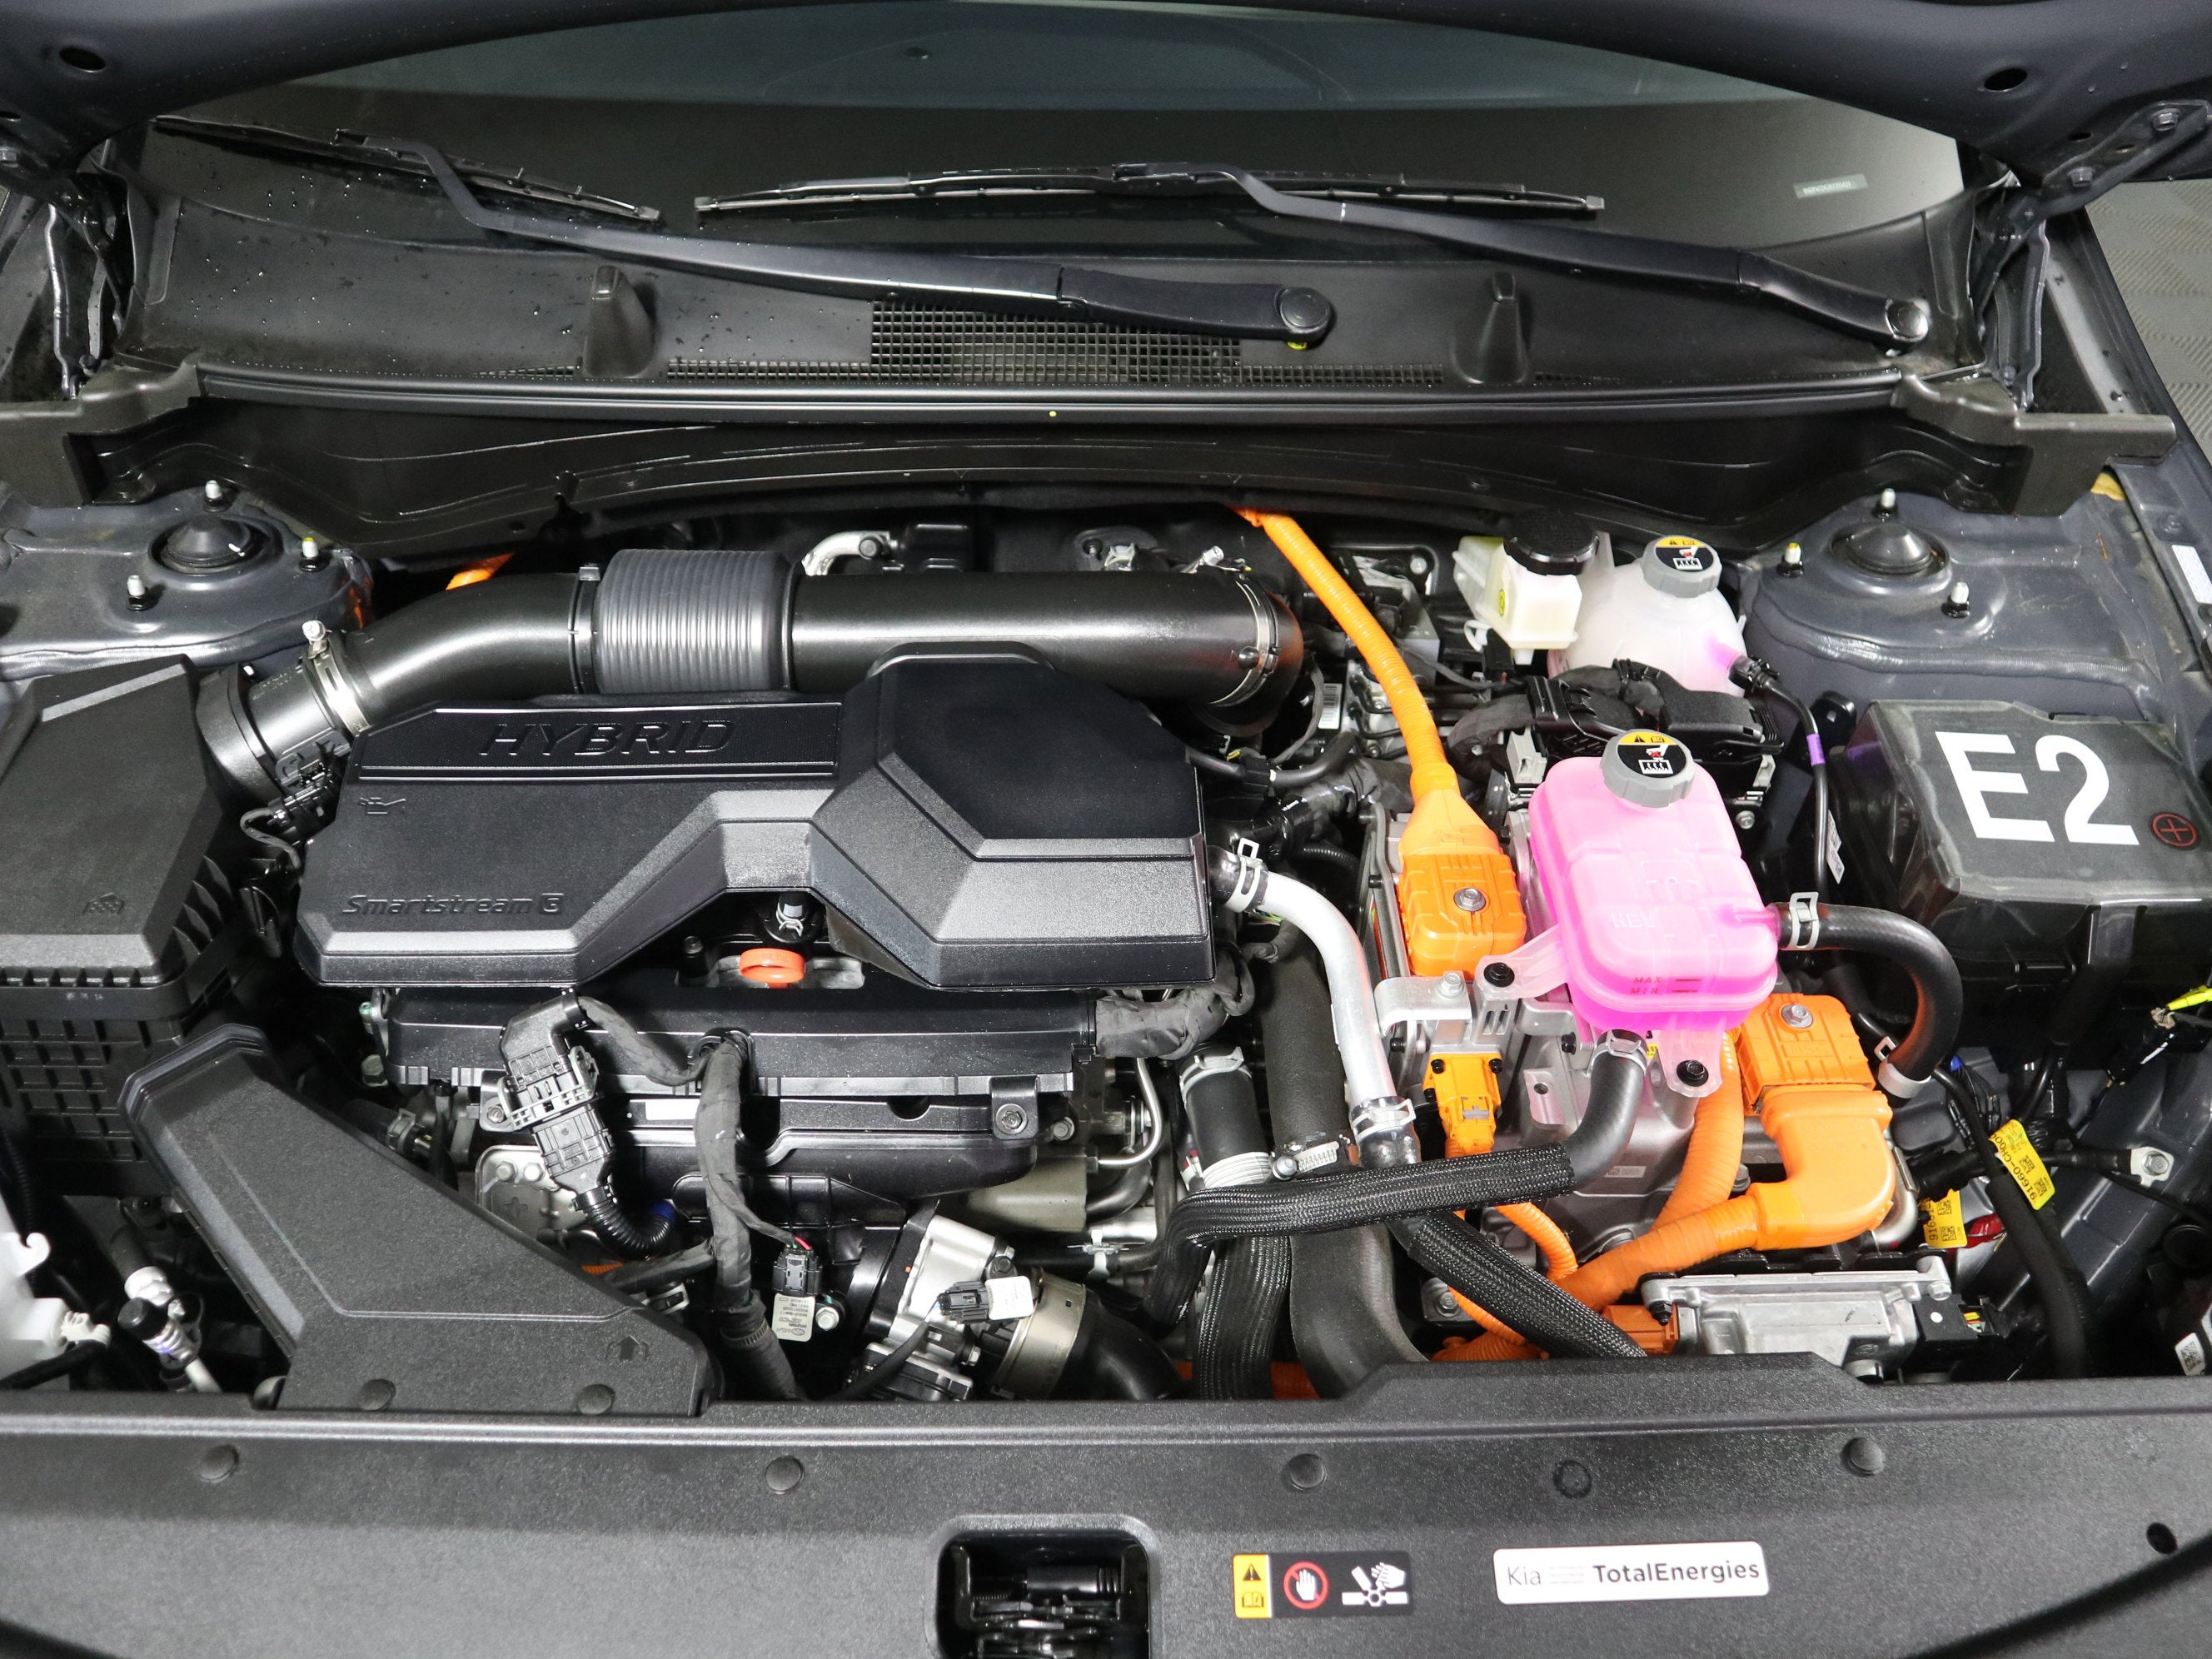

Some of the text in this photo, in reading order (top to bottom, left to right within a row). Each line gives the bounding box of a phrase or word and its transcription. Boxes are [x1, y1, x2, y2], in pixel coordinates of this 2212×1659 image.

[479, 720, 735, 756] HYBRID
[1935, 731, 2140, 845] E2
[342, 894, 533, 915] Smartstream
[1507, 1566, 1542, 1587] Kia
[1592, 1560, 1760, 1583] TotalEnergies
